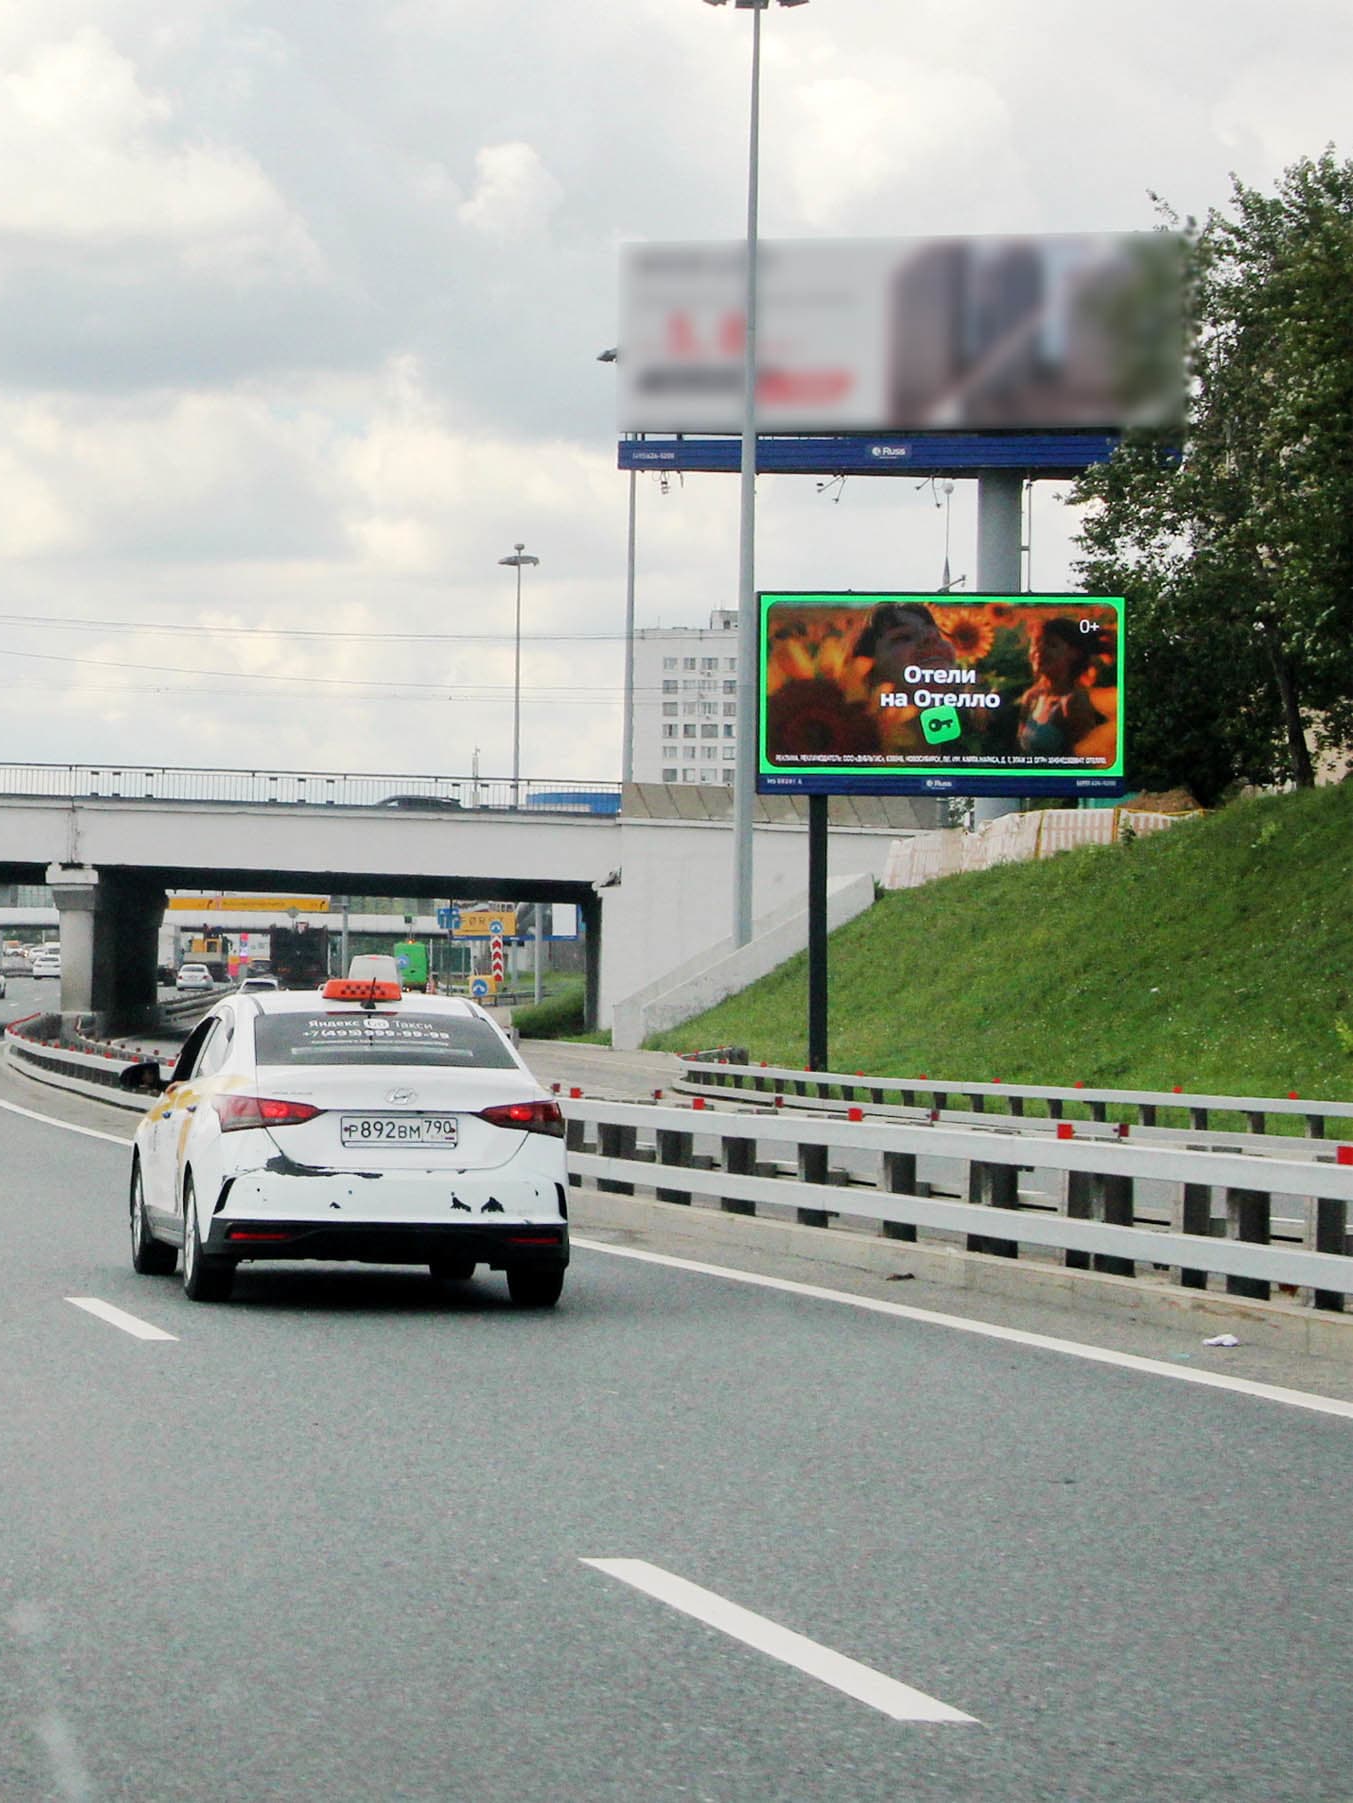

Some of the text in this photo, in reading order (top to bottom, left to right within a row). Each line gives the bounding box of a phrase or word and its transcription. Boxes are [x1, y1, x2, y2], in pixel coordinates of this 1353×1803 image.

[1079, 619, 1100, 634] 0+
[903, 665, 977, 684] Отели
[880, 689, 1001, 708] на Отелло
[308, 1019, 360, 1028] Яндекс
[395, 1020, 433, 1031] Такси
